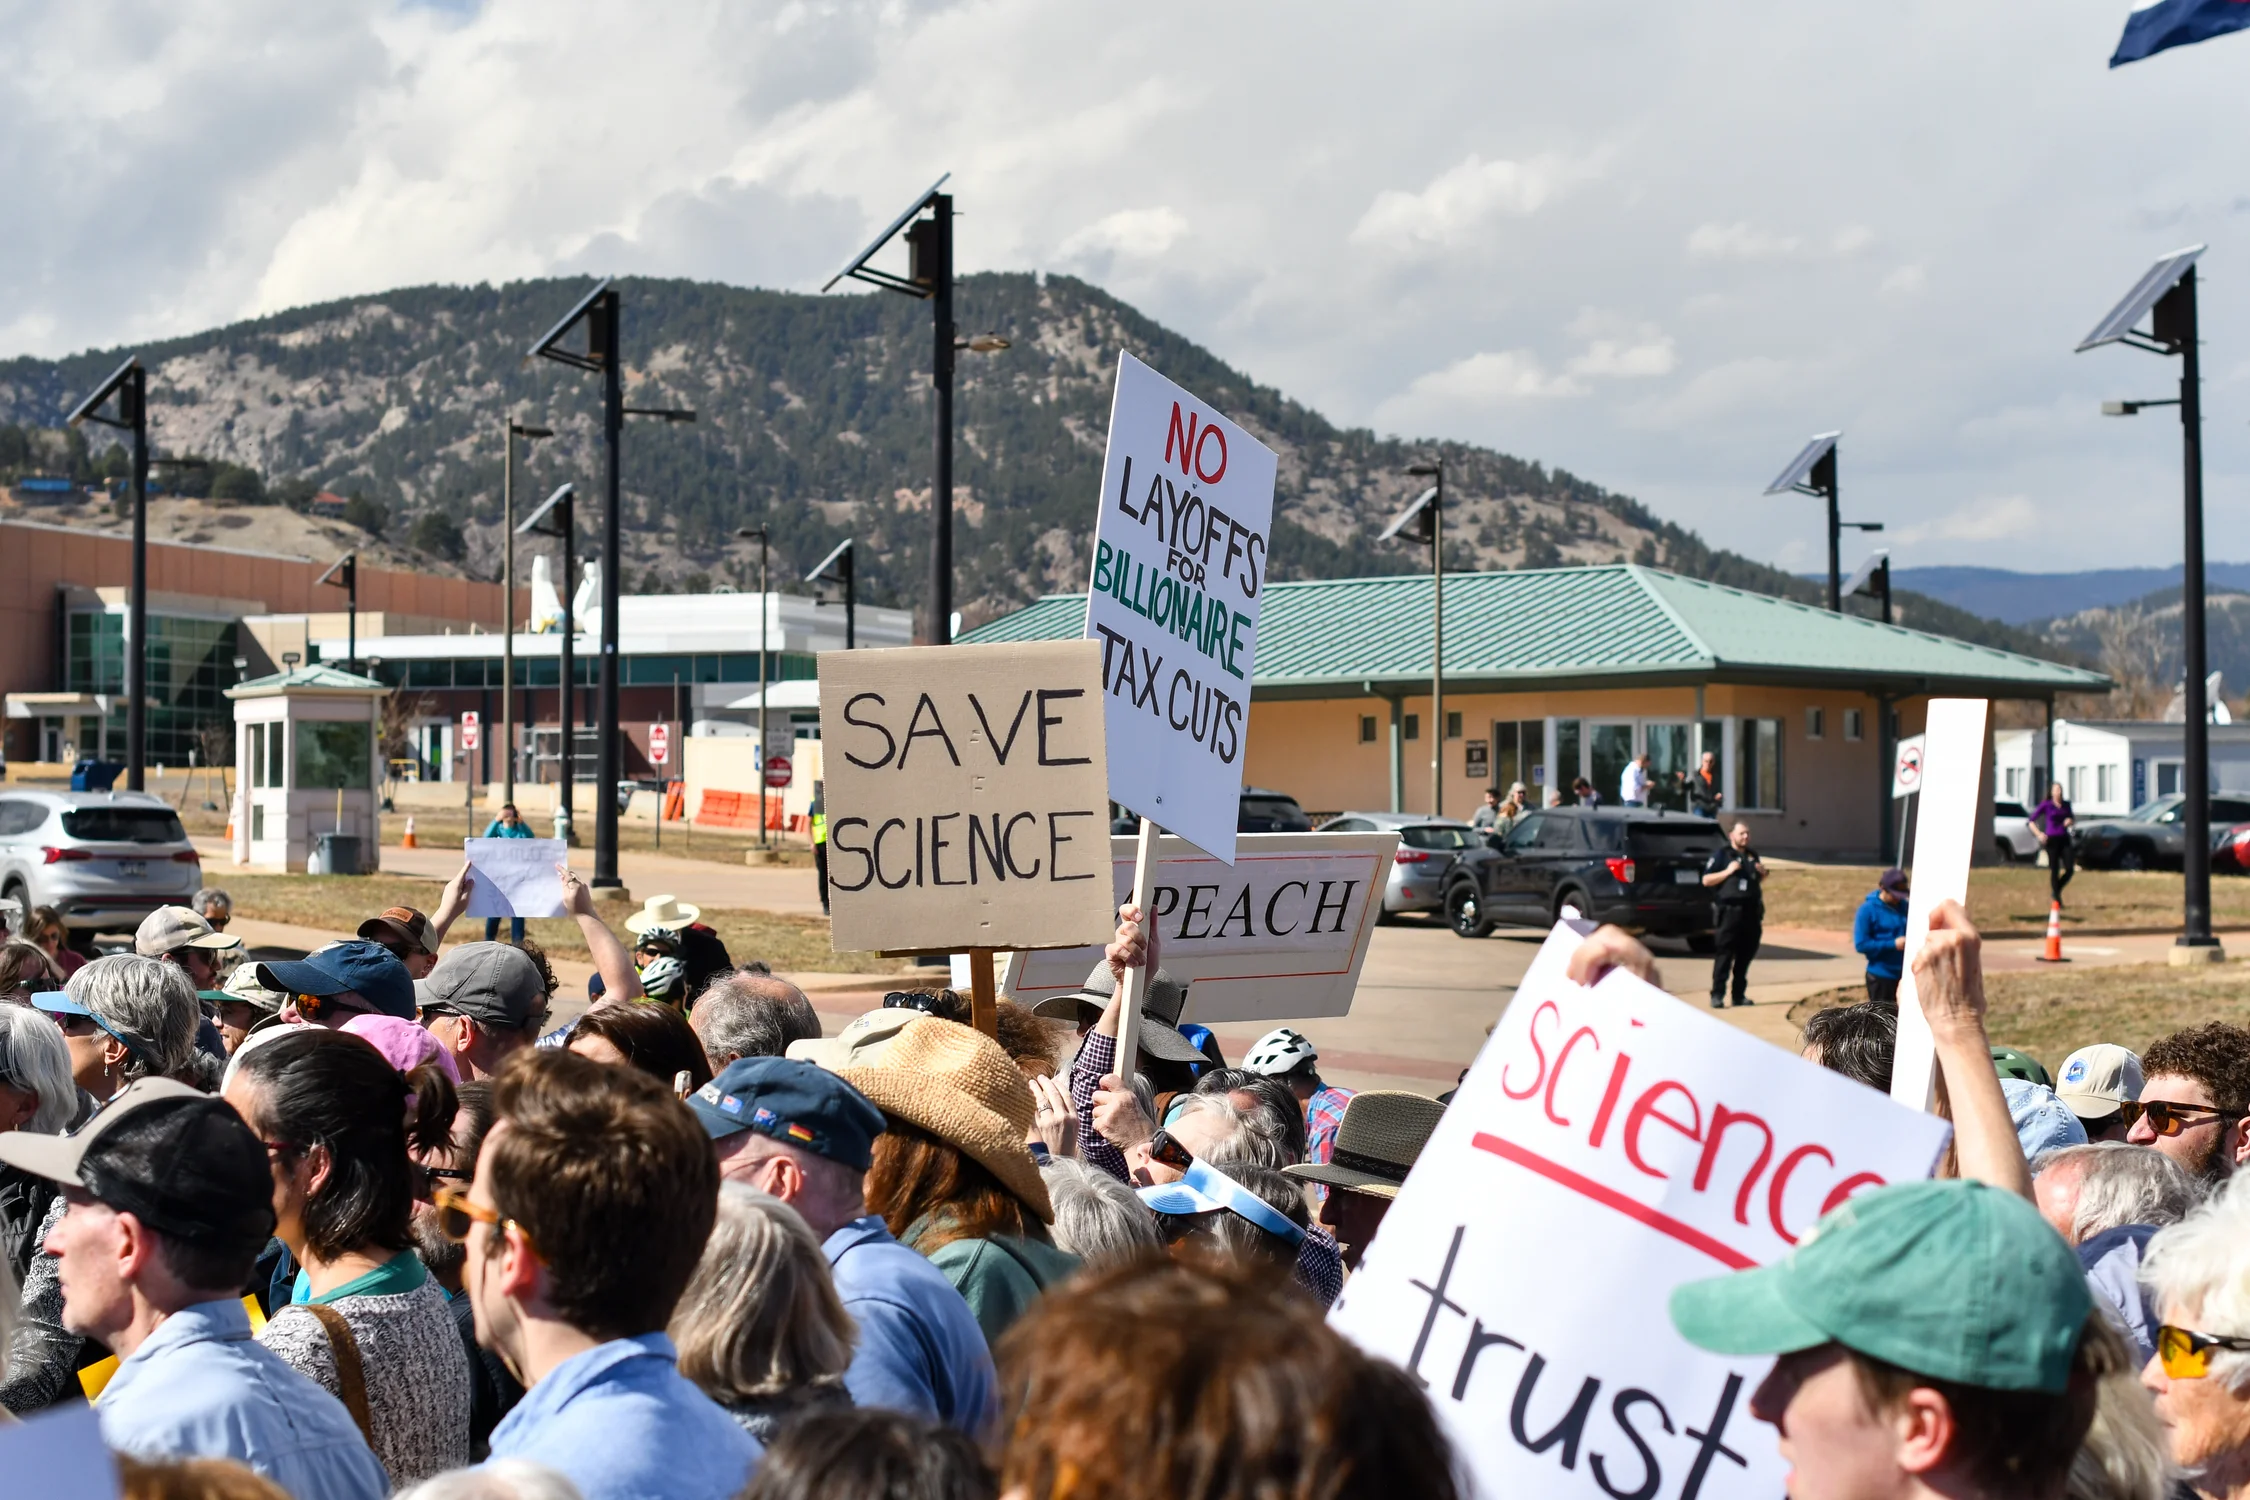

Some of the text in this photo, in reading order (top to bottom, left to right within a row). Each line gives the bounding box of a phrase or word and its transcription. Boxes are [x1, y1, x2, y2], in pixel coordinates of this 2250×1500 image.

[1165, 401, 1227, 484] NO
[1120, 456, 1265, 598] LAYOFFS
[1093, 539, 1251, 680] BILLIONAIRE
[1167, 548, 1206, 591] FOR
[844, 689, 1092, 770] SAVE
[1097, 623, 1242, 764] TAX CUTS
[829, 811, 1095, 891] SCIENCE
[1115, 879, 1360, 940] PEACH
[1409, 1225, 1747, 1500] trust
